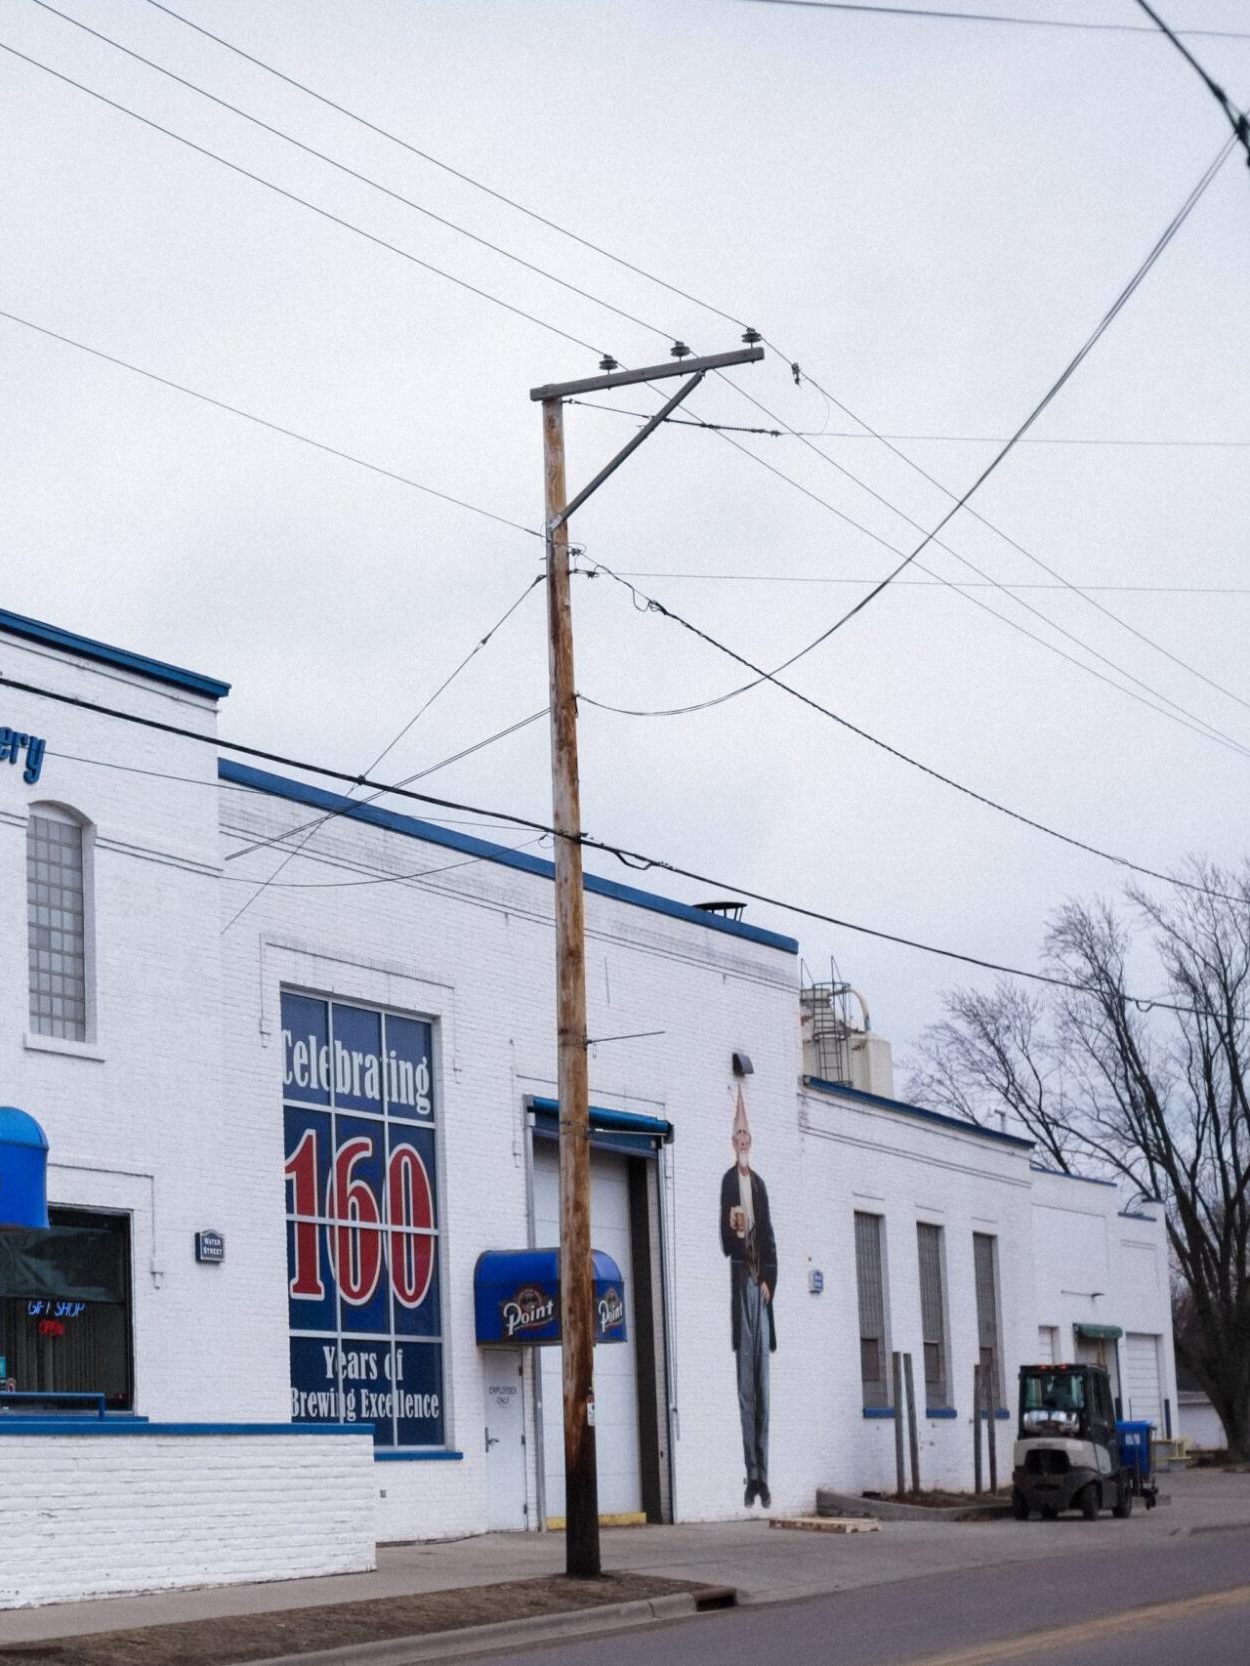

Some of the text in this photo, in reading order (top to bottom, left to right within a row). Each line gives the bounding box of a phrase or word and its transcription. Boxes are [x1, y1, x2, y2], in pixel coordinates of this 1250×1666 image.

[285, 1128, 434, 1309] 160
[54, 1301, 86, 1317] SHOP
[503, 1300, 554, 1336] Point
[598, 1300, 623, 1333] Point
[322, 1346, 377, 1380] Years
[360, 1389, 440, 1418] Excellence
